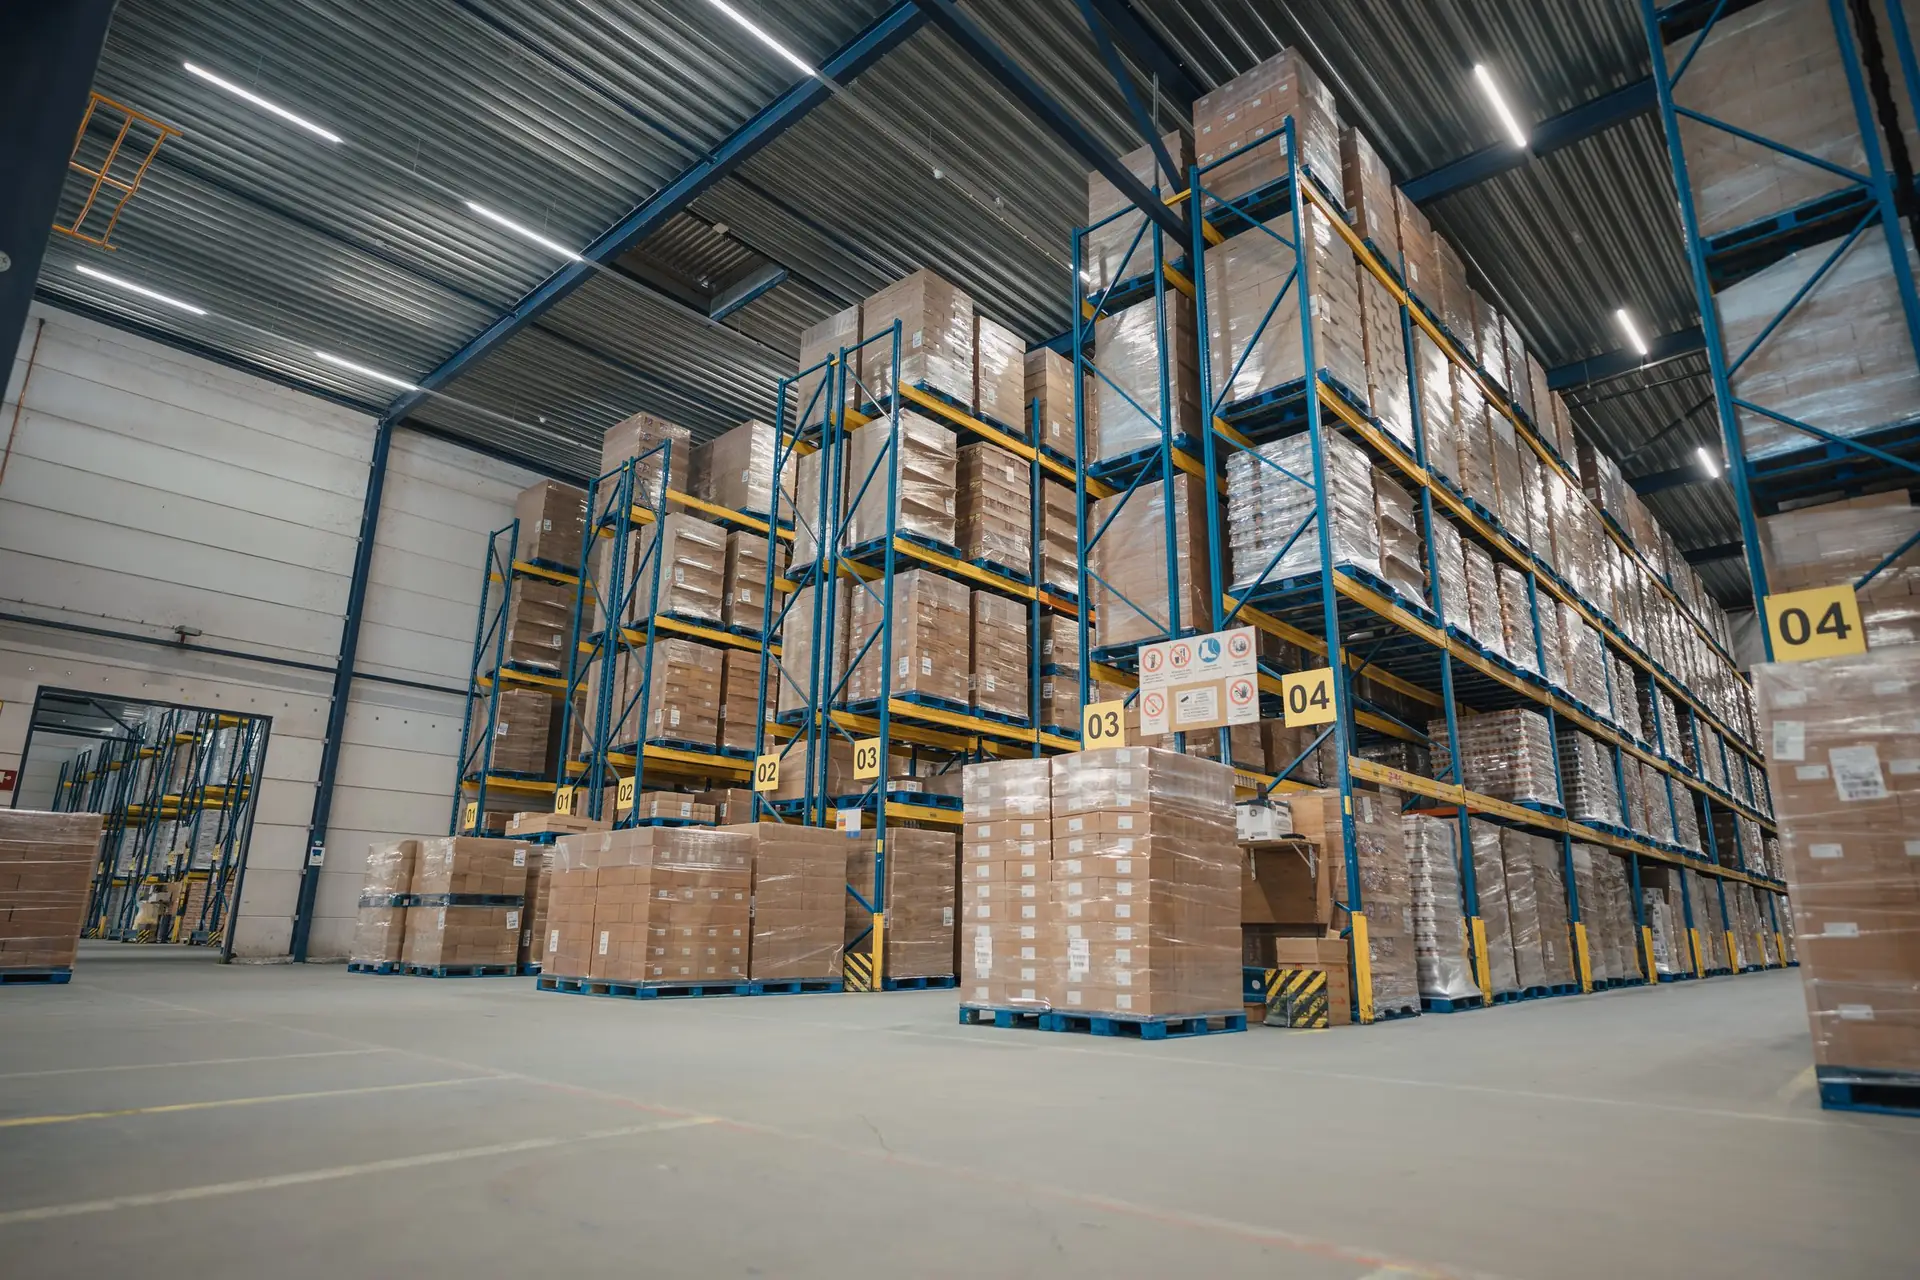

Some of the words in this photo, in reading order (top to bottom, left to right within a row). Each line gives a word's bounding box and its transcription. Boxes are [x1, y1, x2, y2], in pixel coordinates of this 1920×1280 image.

[1779, 601, 1852, 645] 04
[1289, 680, 1330, 714] 04
[1088, 711, 1120, 740] 03
[857, 747, 877, 770] 03
[758, 762, 776, 783] 02
[557, 793, 569, 810] 01
[620, 784, 633, 801] 02
[467, 808, 476, 823] 01
